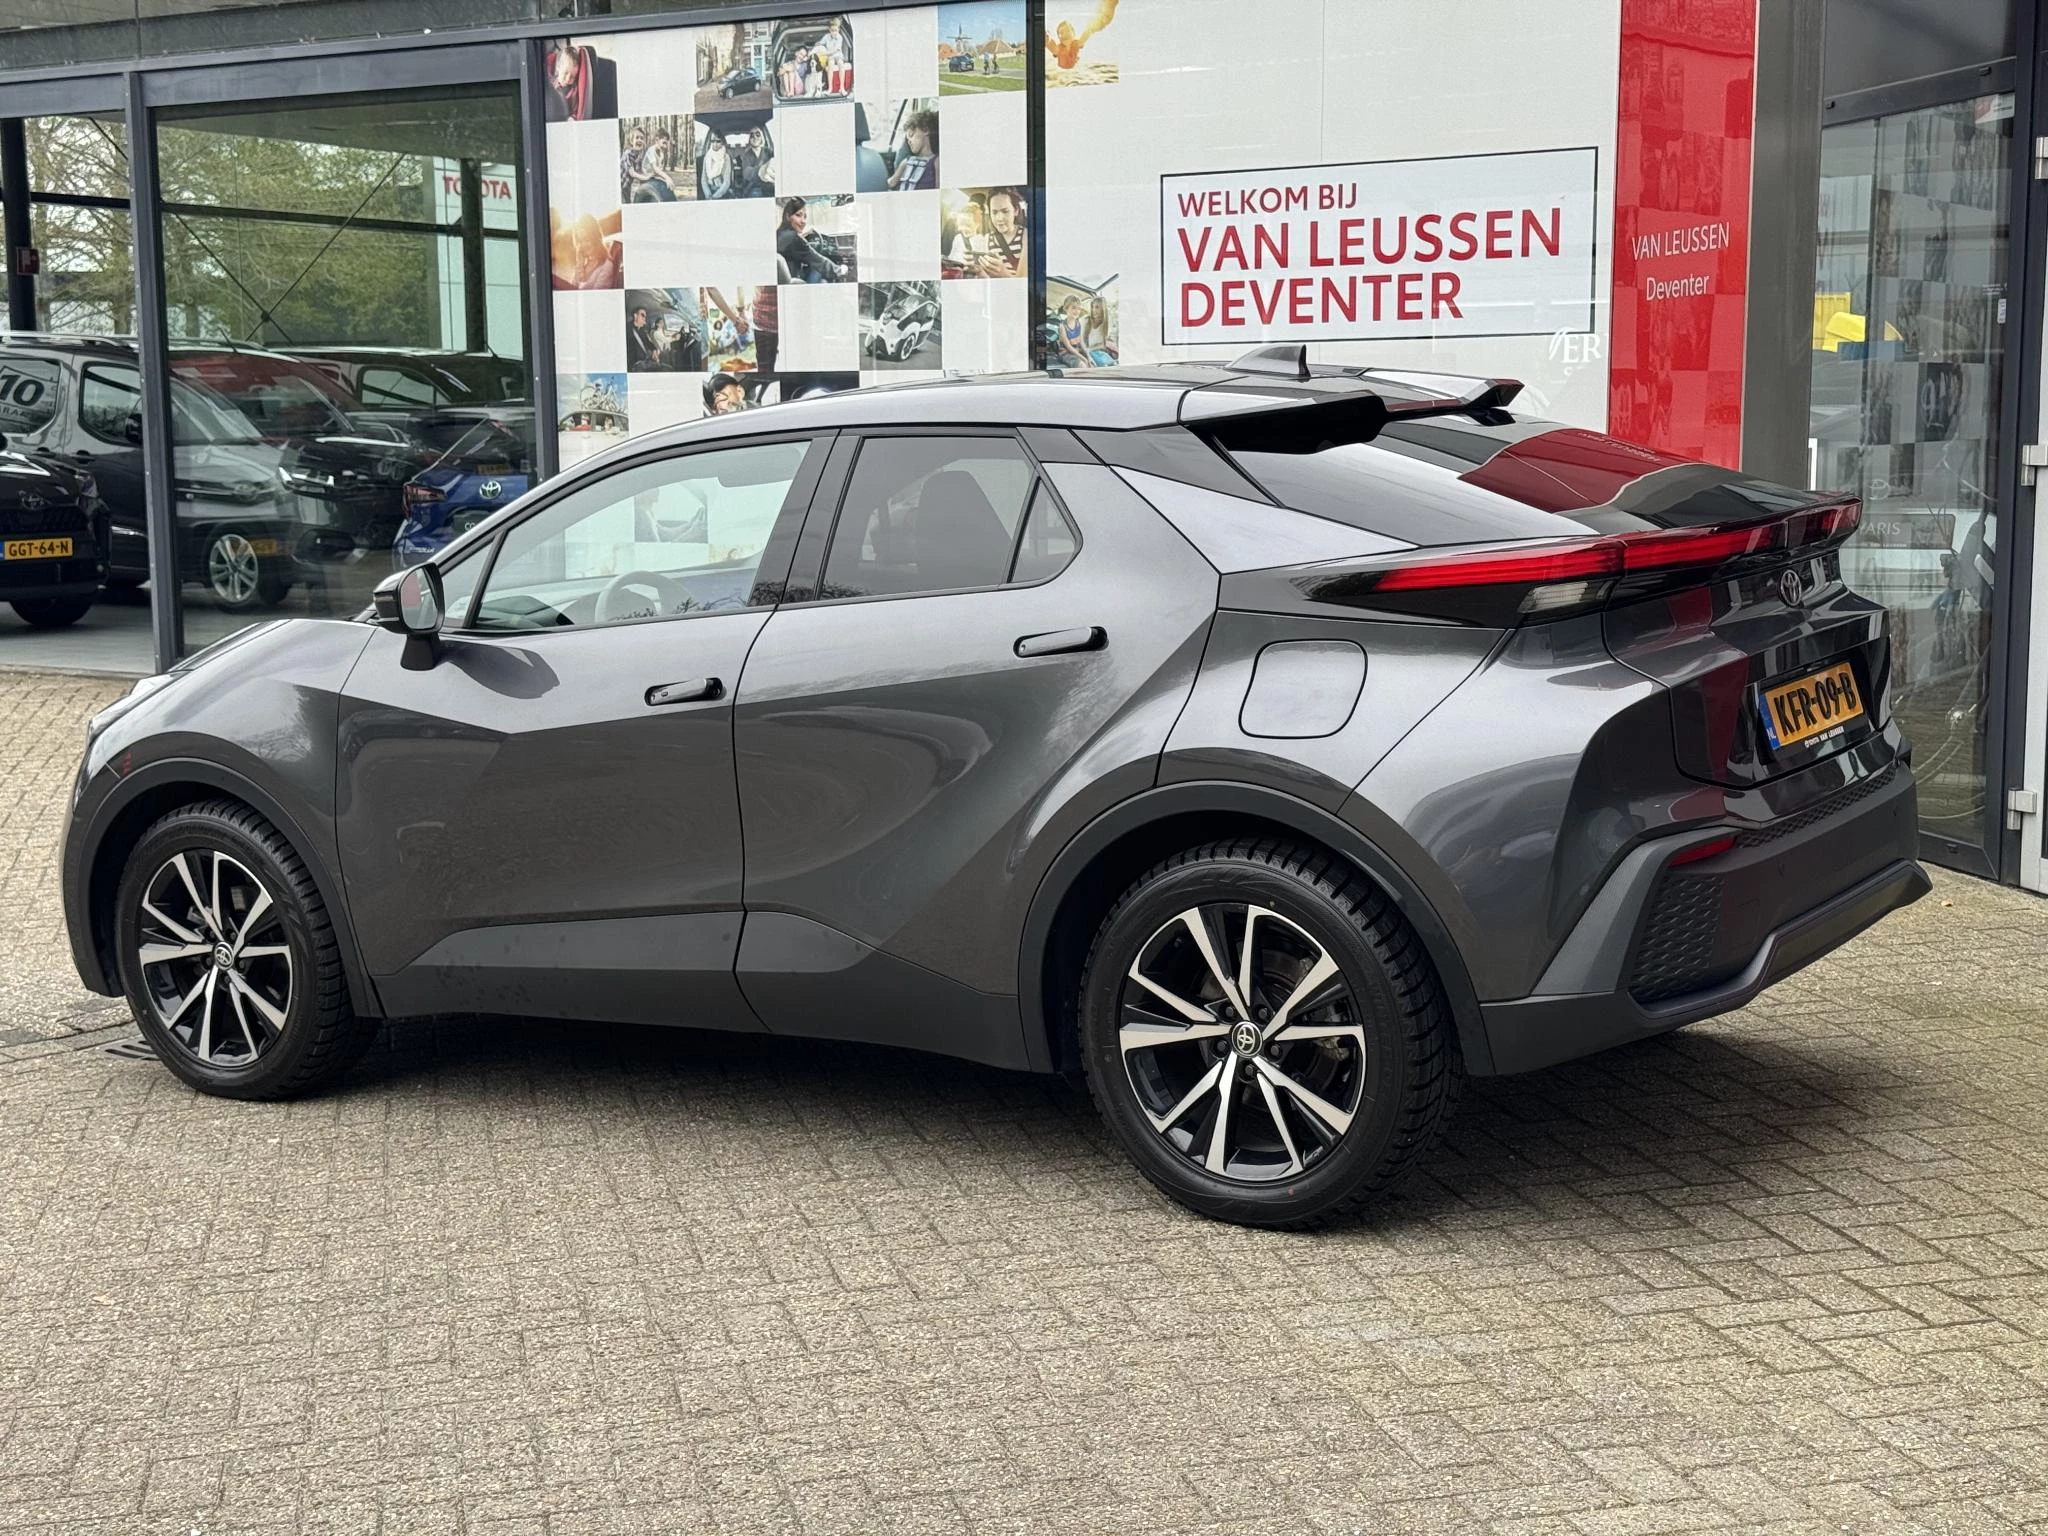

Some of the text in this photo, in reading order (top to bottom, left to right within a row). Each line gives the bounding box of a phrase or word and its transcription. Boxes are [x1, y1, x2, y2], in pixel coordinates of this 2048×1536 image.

[443, 175, 512, 200] TOOTA
[1178, 183, 1358, 218] WELKOM BIJ
[1178, 207, 1561, 273] VAN LEUSSEN
[1631, 221, 1730, 261] VAN LEUSSEN
[1181, 271, 1464, 328] DEVENTER
[1646, 273, 1710, 301] Deventer
[8, 541, 69, 557] GGT-64-N
[1773, 672, 1857, 737] KFR-09-B
